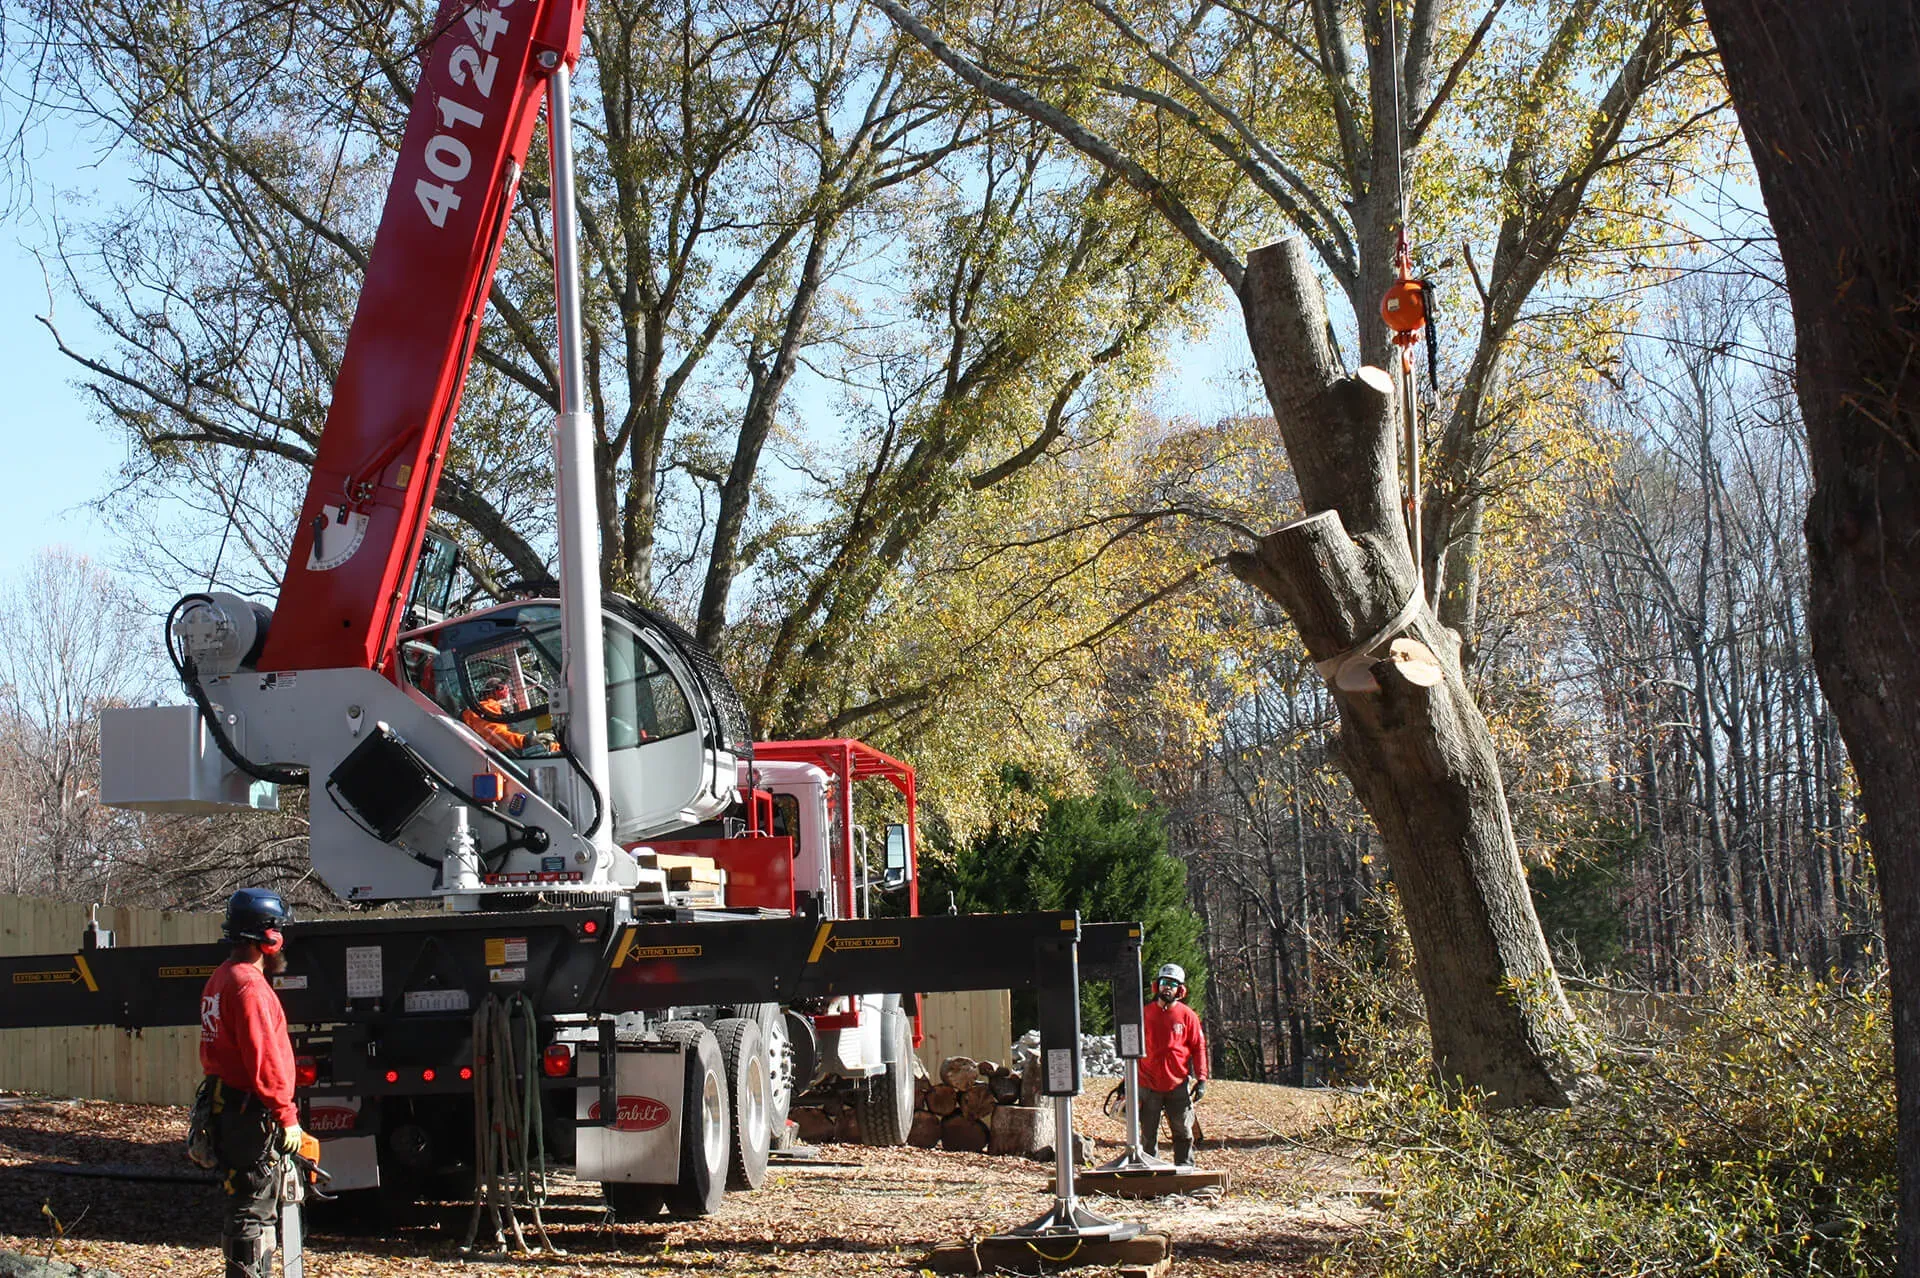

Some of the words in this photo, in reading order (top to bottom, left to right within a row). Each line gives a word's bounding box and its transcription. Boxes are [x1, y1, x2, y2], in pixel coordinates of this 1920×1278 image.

[448, 0, 516, 99] 24
[414, 95, 485, 229] 401
[616, 1104, 663, 1121] erbilt
